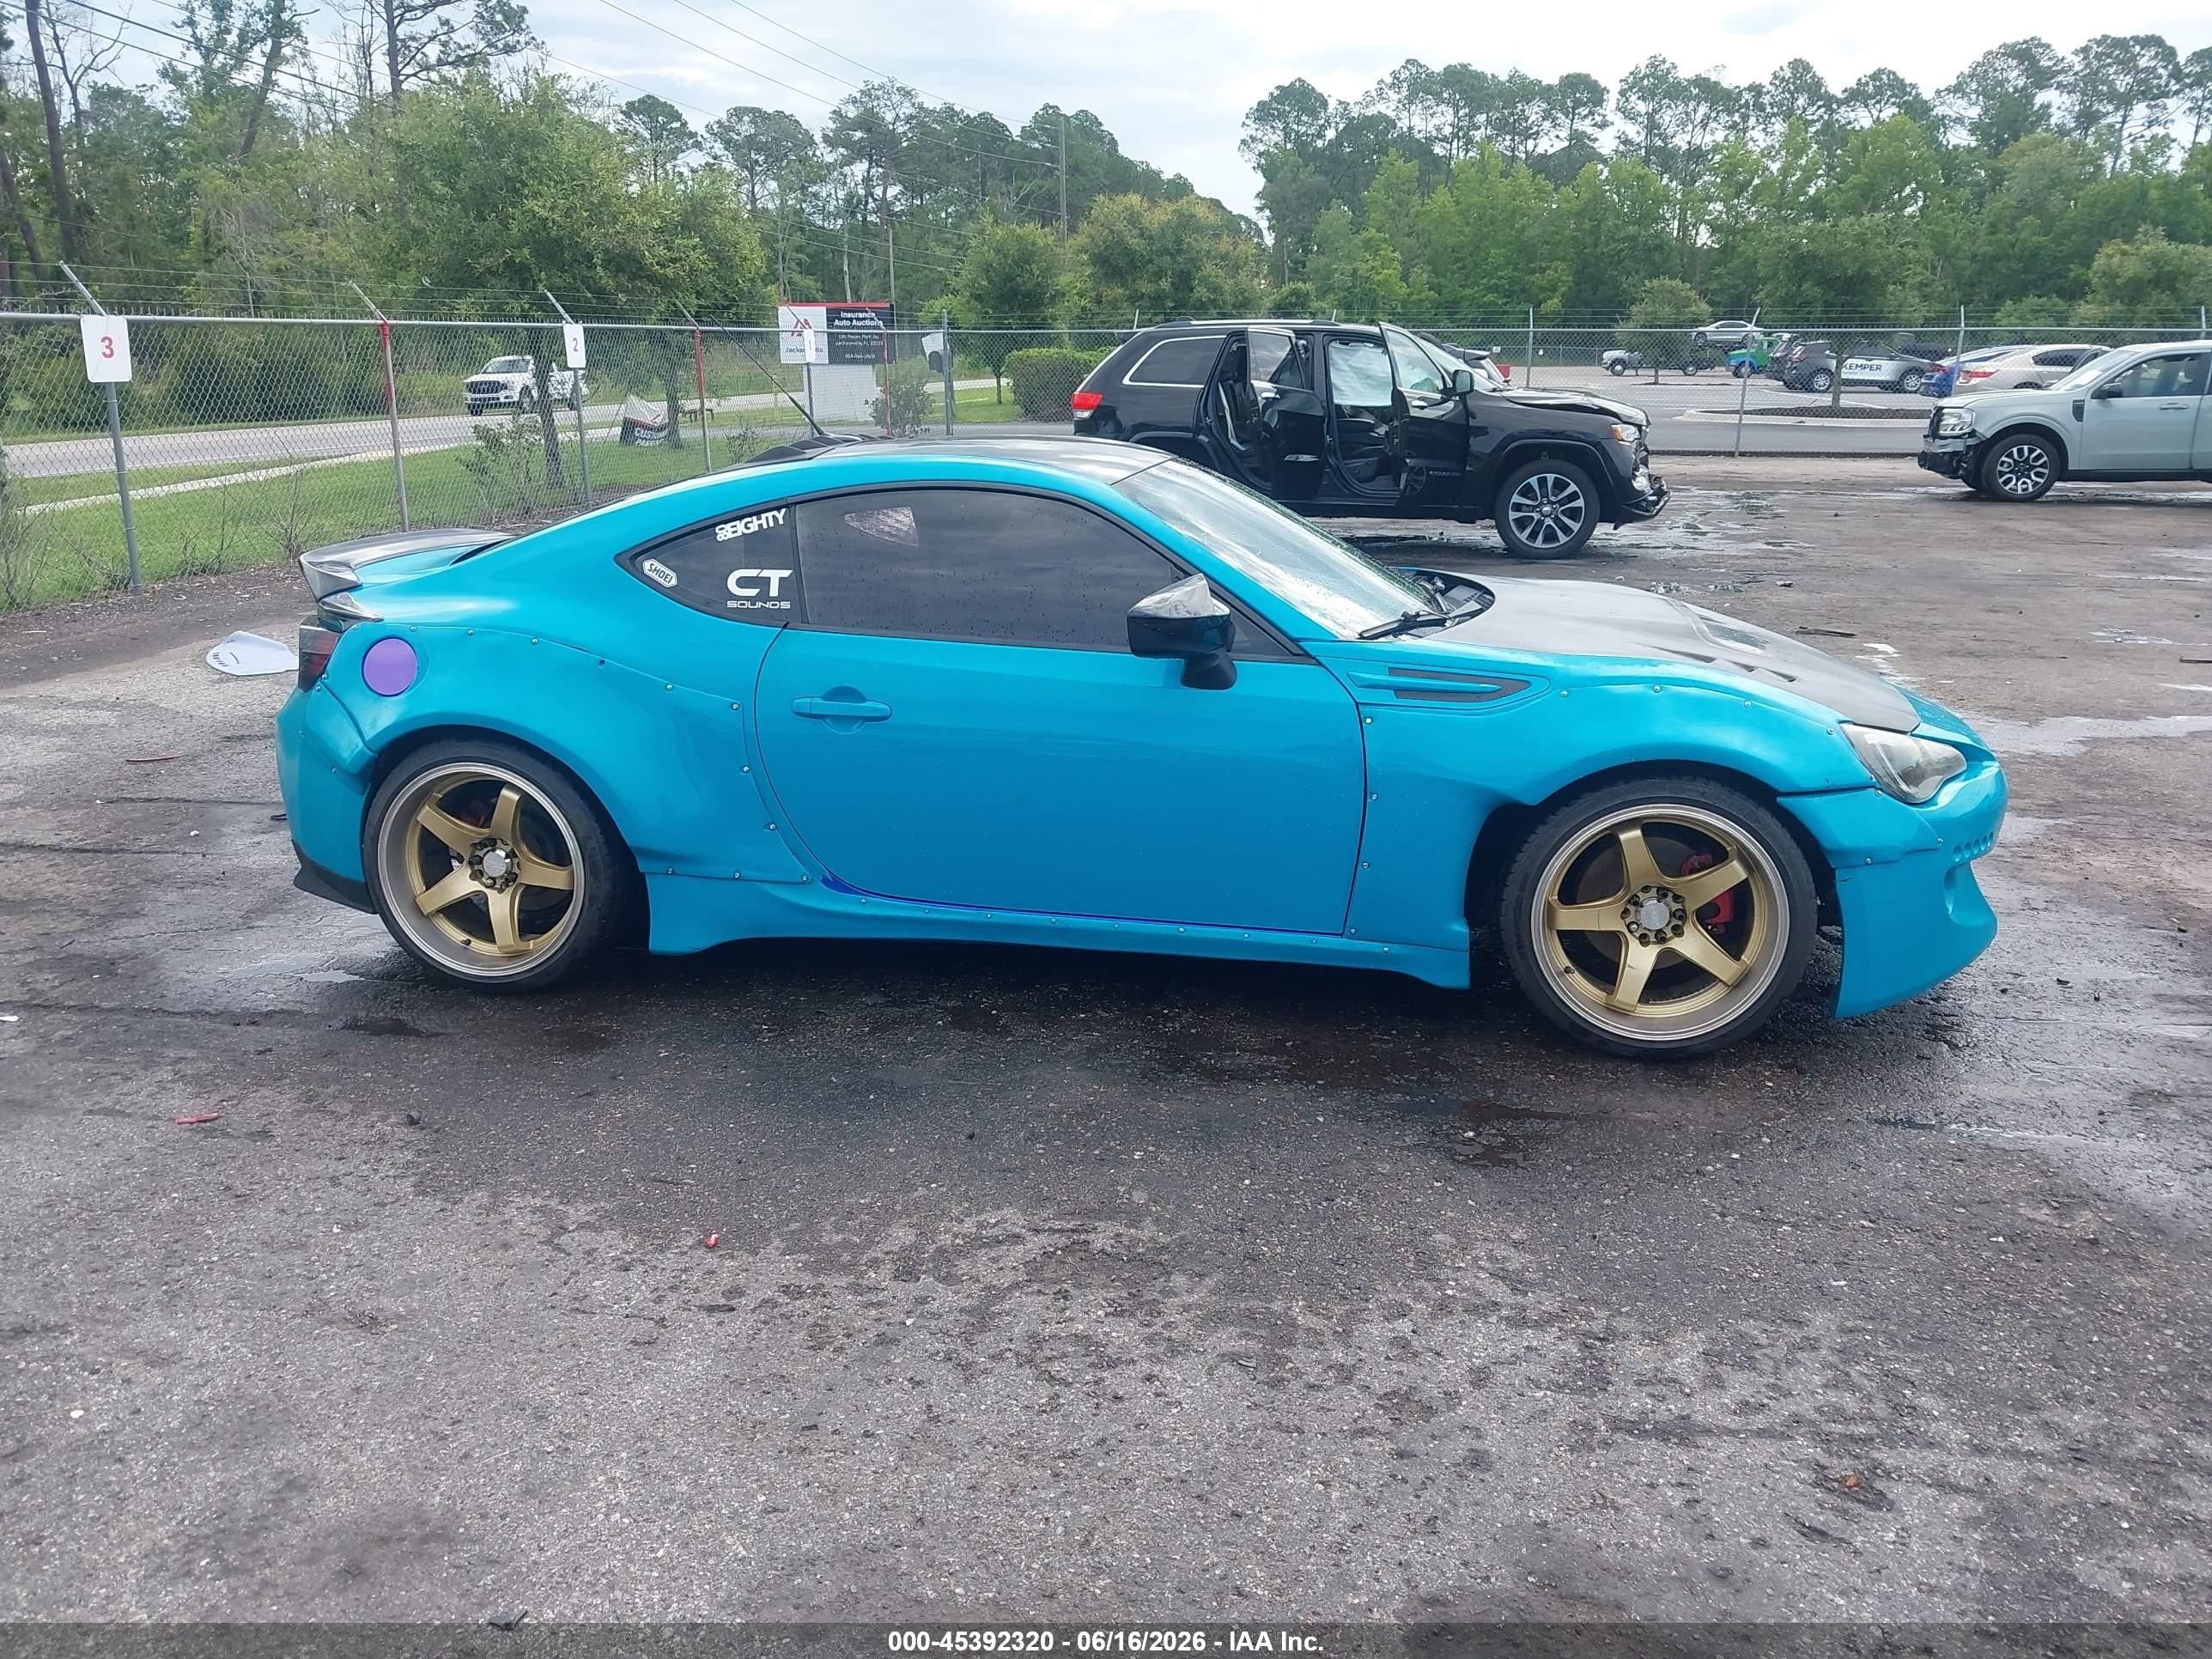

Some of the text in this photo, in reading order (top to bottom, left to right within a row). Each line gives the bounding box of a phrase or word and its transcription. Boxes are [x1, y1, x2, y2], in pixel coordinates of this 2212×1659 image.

[100, 336, 114, 359] 3
[573, 337, 579, 352] 2
[647, 562, 674, 585] SHOEI
[726, 568, 793, 598] CT
[726, 600, 791, 609] SOUNDS
